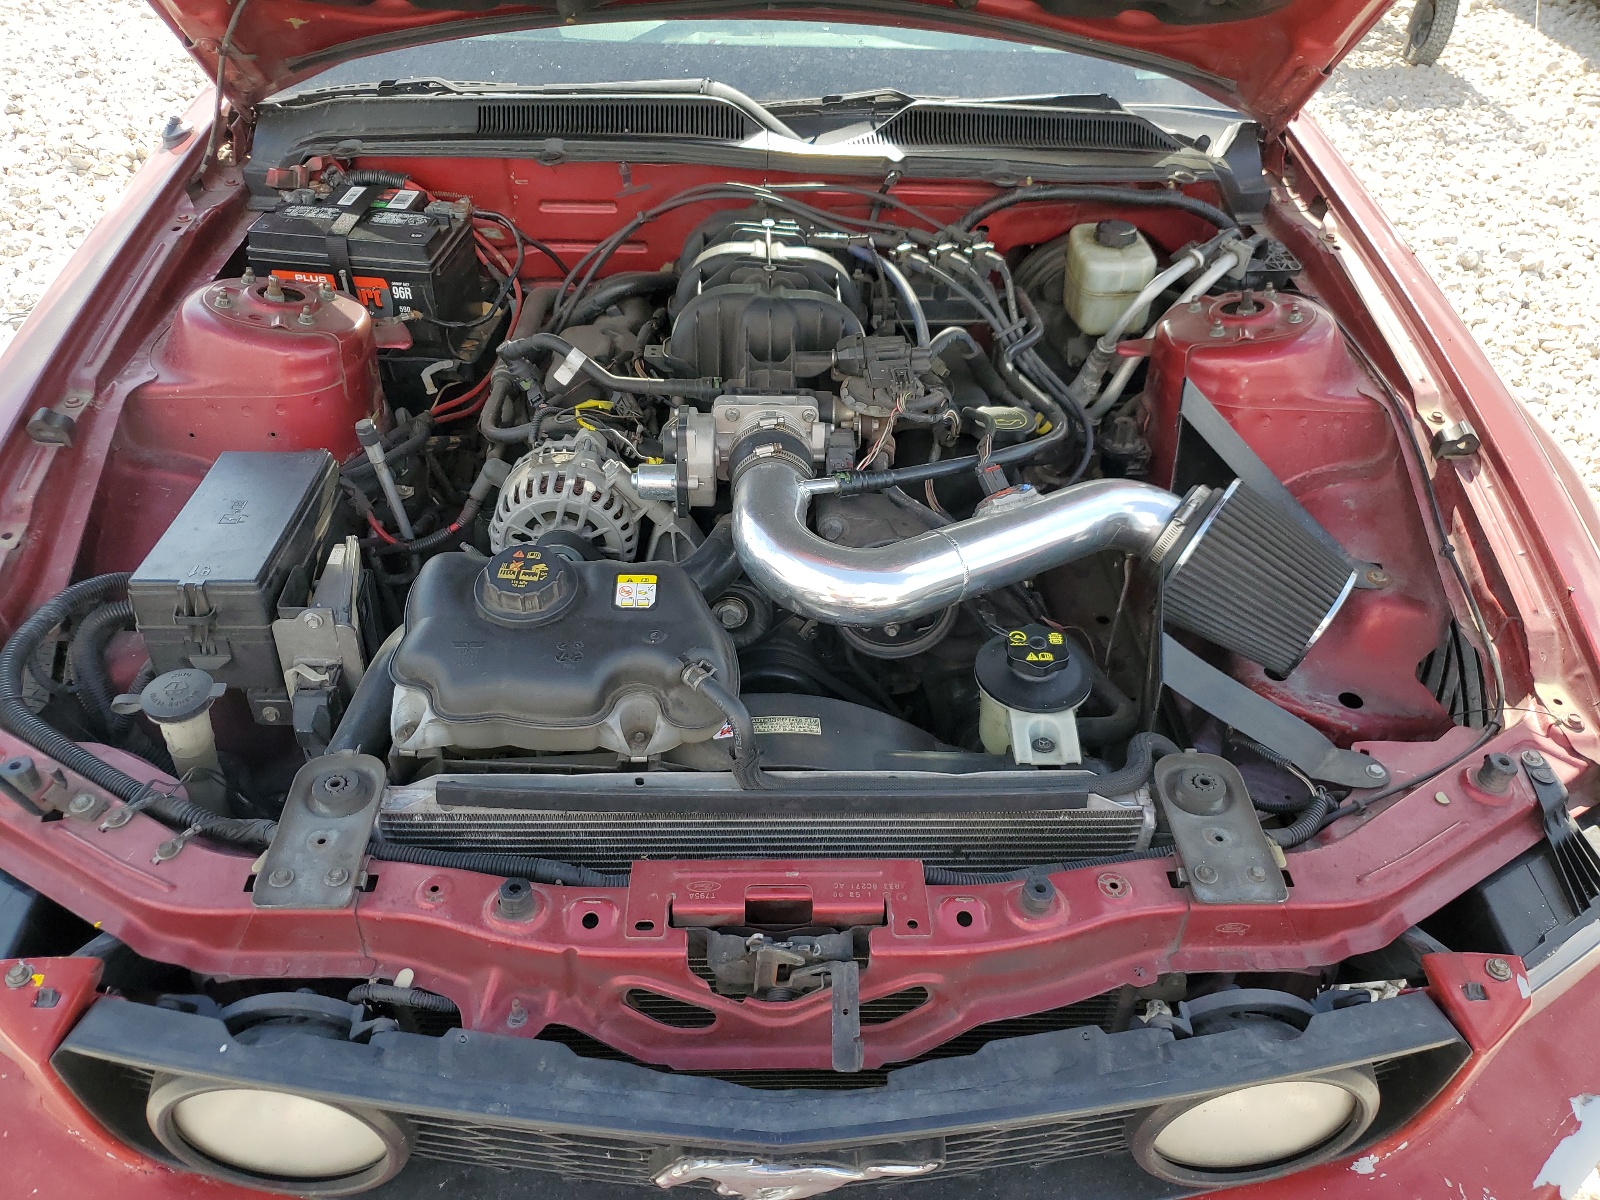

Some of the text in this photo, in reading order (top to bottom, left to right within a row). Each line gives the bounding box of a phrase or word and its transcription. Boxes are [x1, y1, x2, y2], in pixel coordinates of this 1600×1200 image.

[294, 274, 327, 283] PLUS
[392, 286, 412, 299] 96R
[399, 305, 410, 313] 590
[689, 892, 716, 900] T795A
